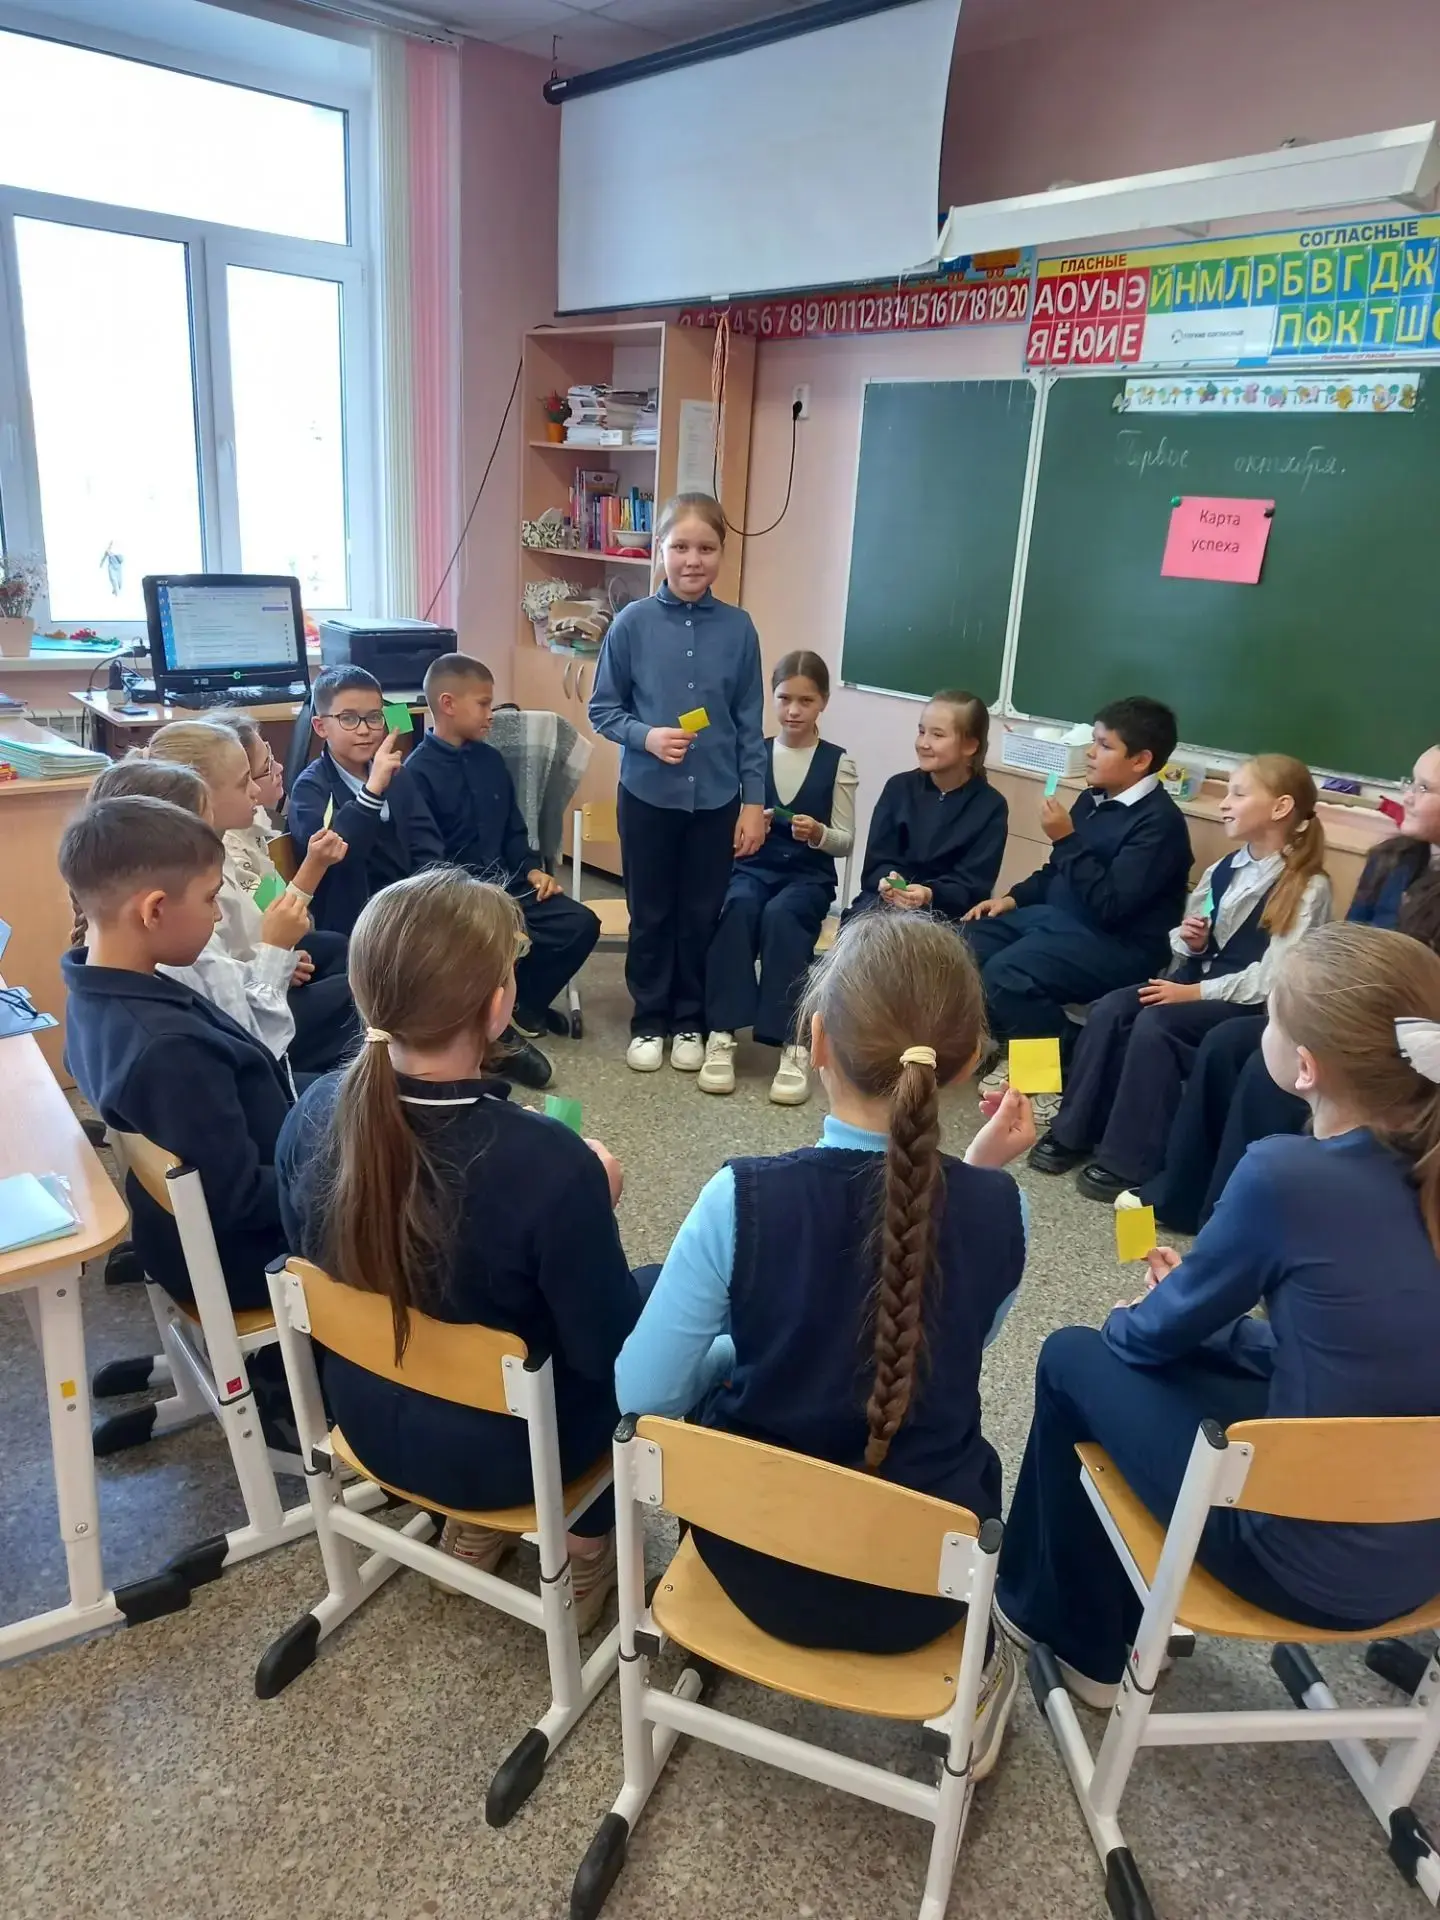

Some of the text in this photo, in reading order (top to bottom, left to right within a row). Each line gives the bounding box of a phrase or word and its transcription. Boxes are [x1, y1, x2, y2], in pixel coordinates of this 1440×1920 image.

[1300, 221, 1418, 248] СОГЛАСНЫЕ
[1060, 253, 1128, 273] ГЛАСНЫЕ
[1199, 508, 1241, 528] Карта
[1191, 537, 1241, 554] успеха
